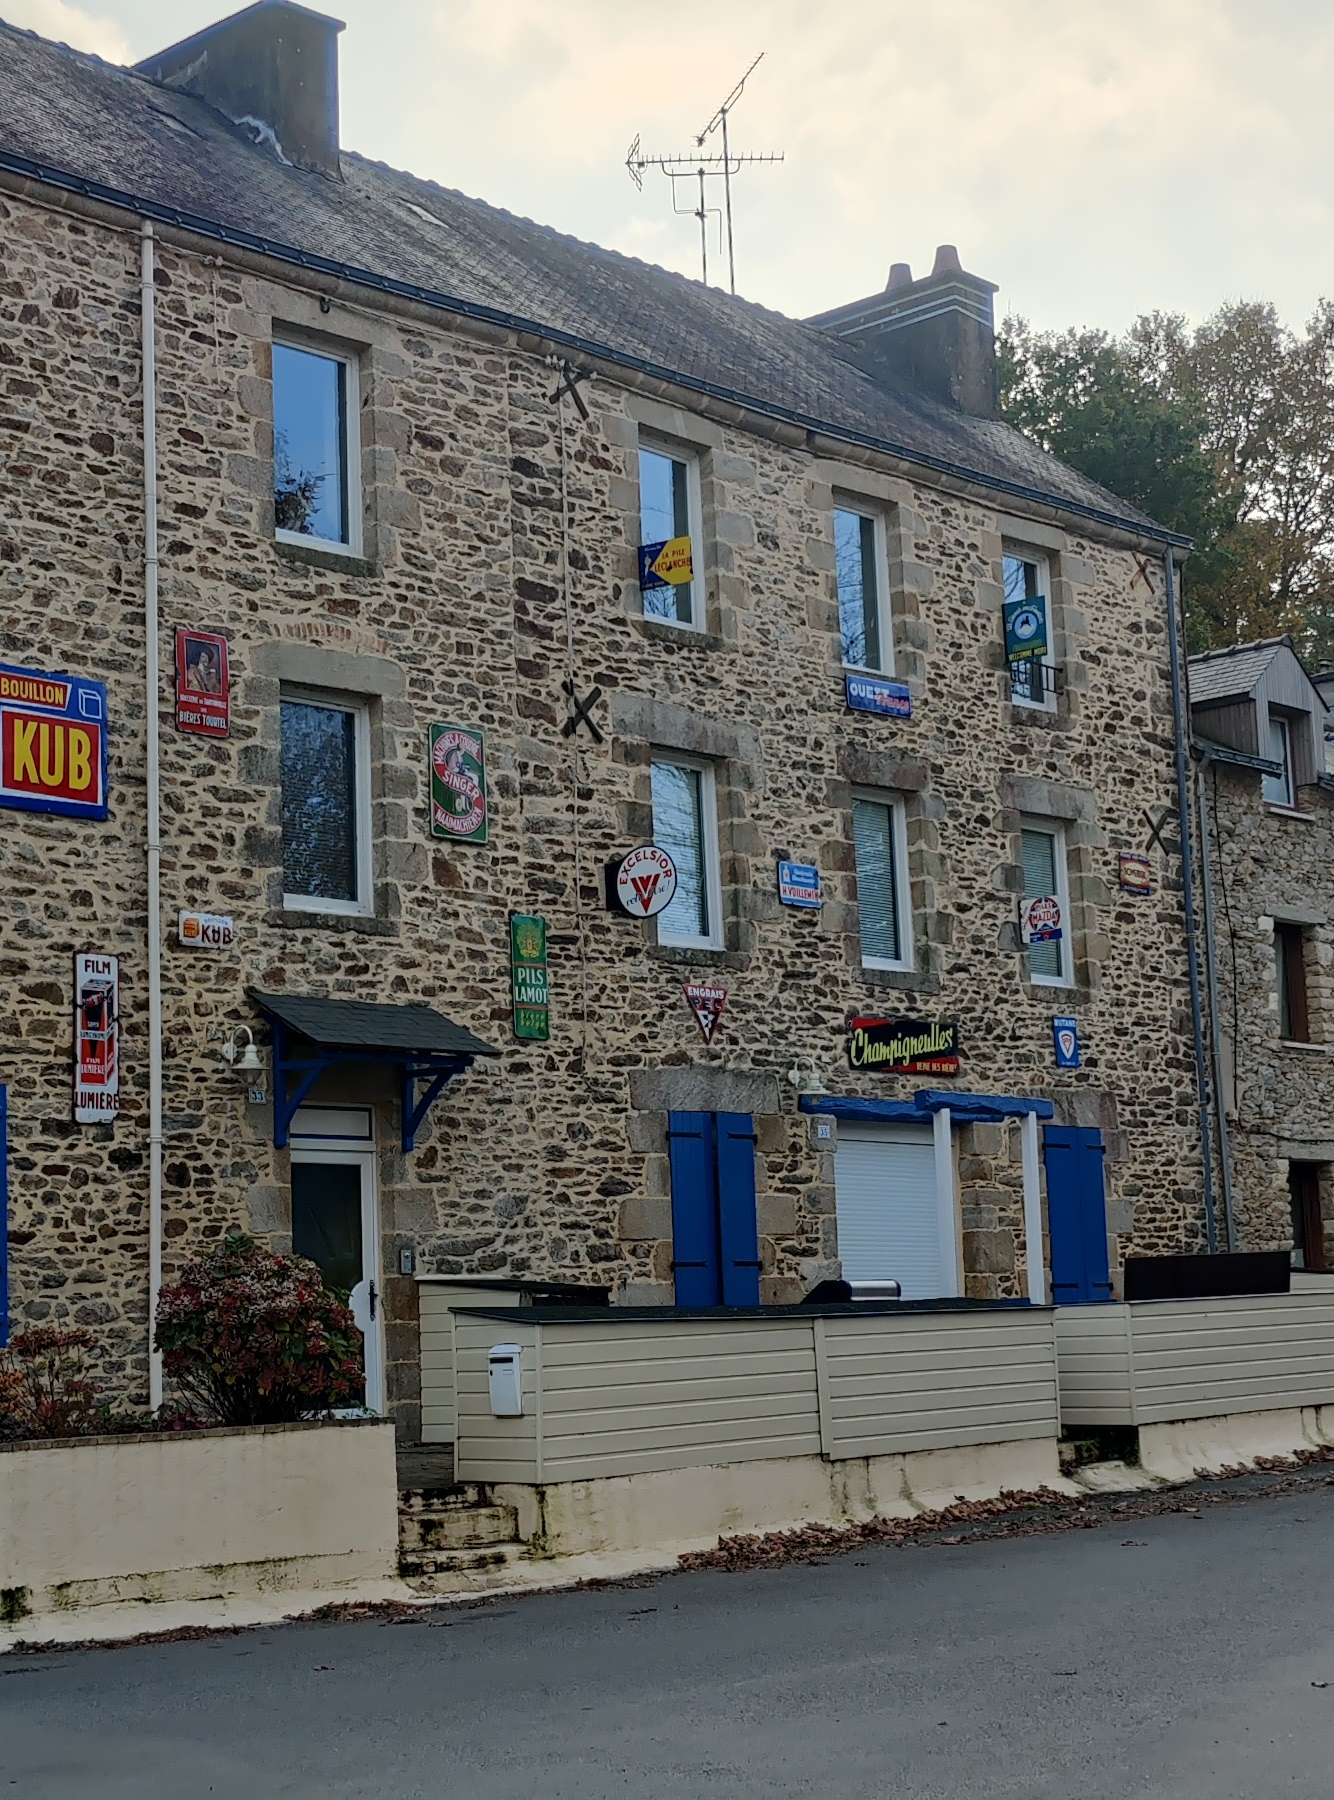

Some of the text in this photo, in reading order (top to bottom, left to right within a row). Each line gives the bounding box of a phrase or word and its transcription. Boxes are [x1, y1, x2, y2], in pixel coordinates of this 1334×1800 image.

[662, 548, 685, 560] LA PILE
[0, 677, 64, 705] BOUILLON
[179, 710, 201, 725] BIÈRES
[13, 718, 92, 791] KUB
[443, 770, 480, 800] SINGER
[619, 850, 673, 885] EXCELSIOR
[201, 924, 233, 945] KUB
[85, 959, 111, 975] FILM
[517, 967, 544, 985] PILS
[515, 986, 548, 1004] LAMOT
[687, 986, 725, 1000] ENGRAIS
[850, 1022, 953, 1067] Champigneulles
[75, 1091, 119, 1110] LUMIÈRE
[251, 1091, 263, 1100] 33
